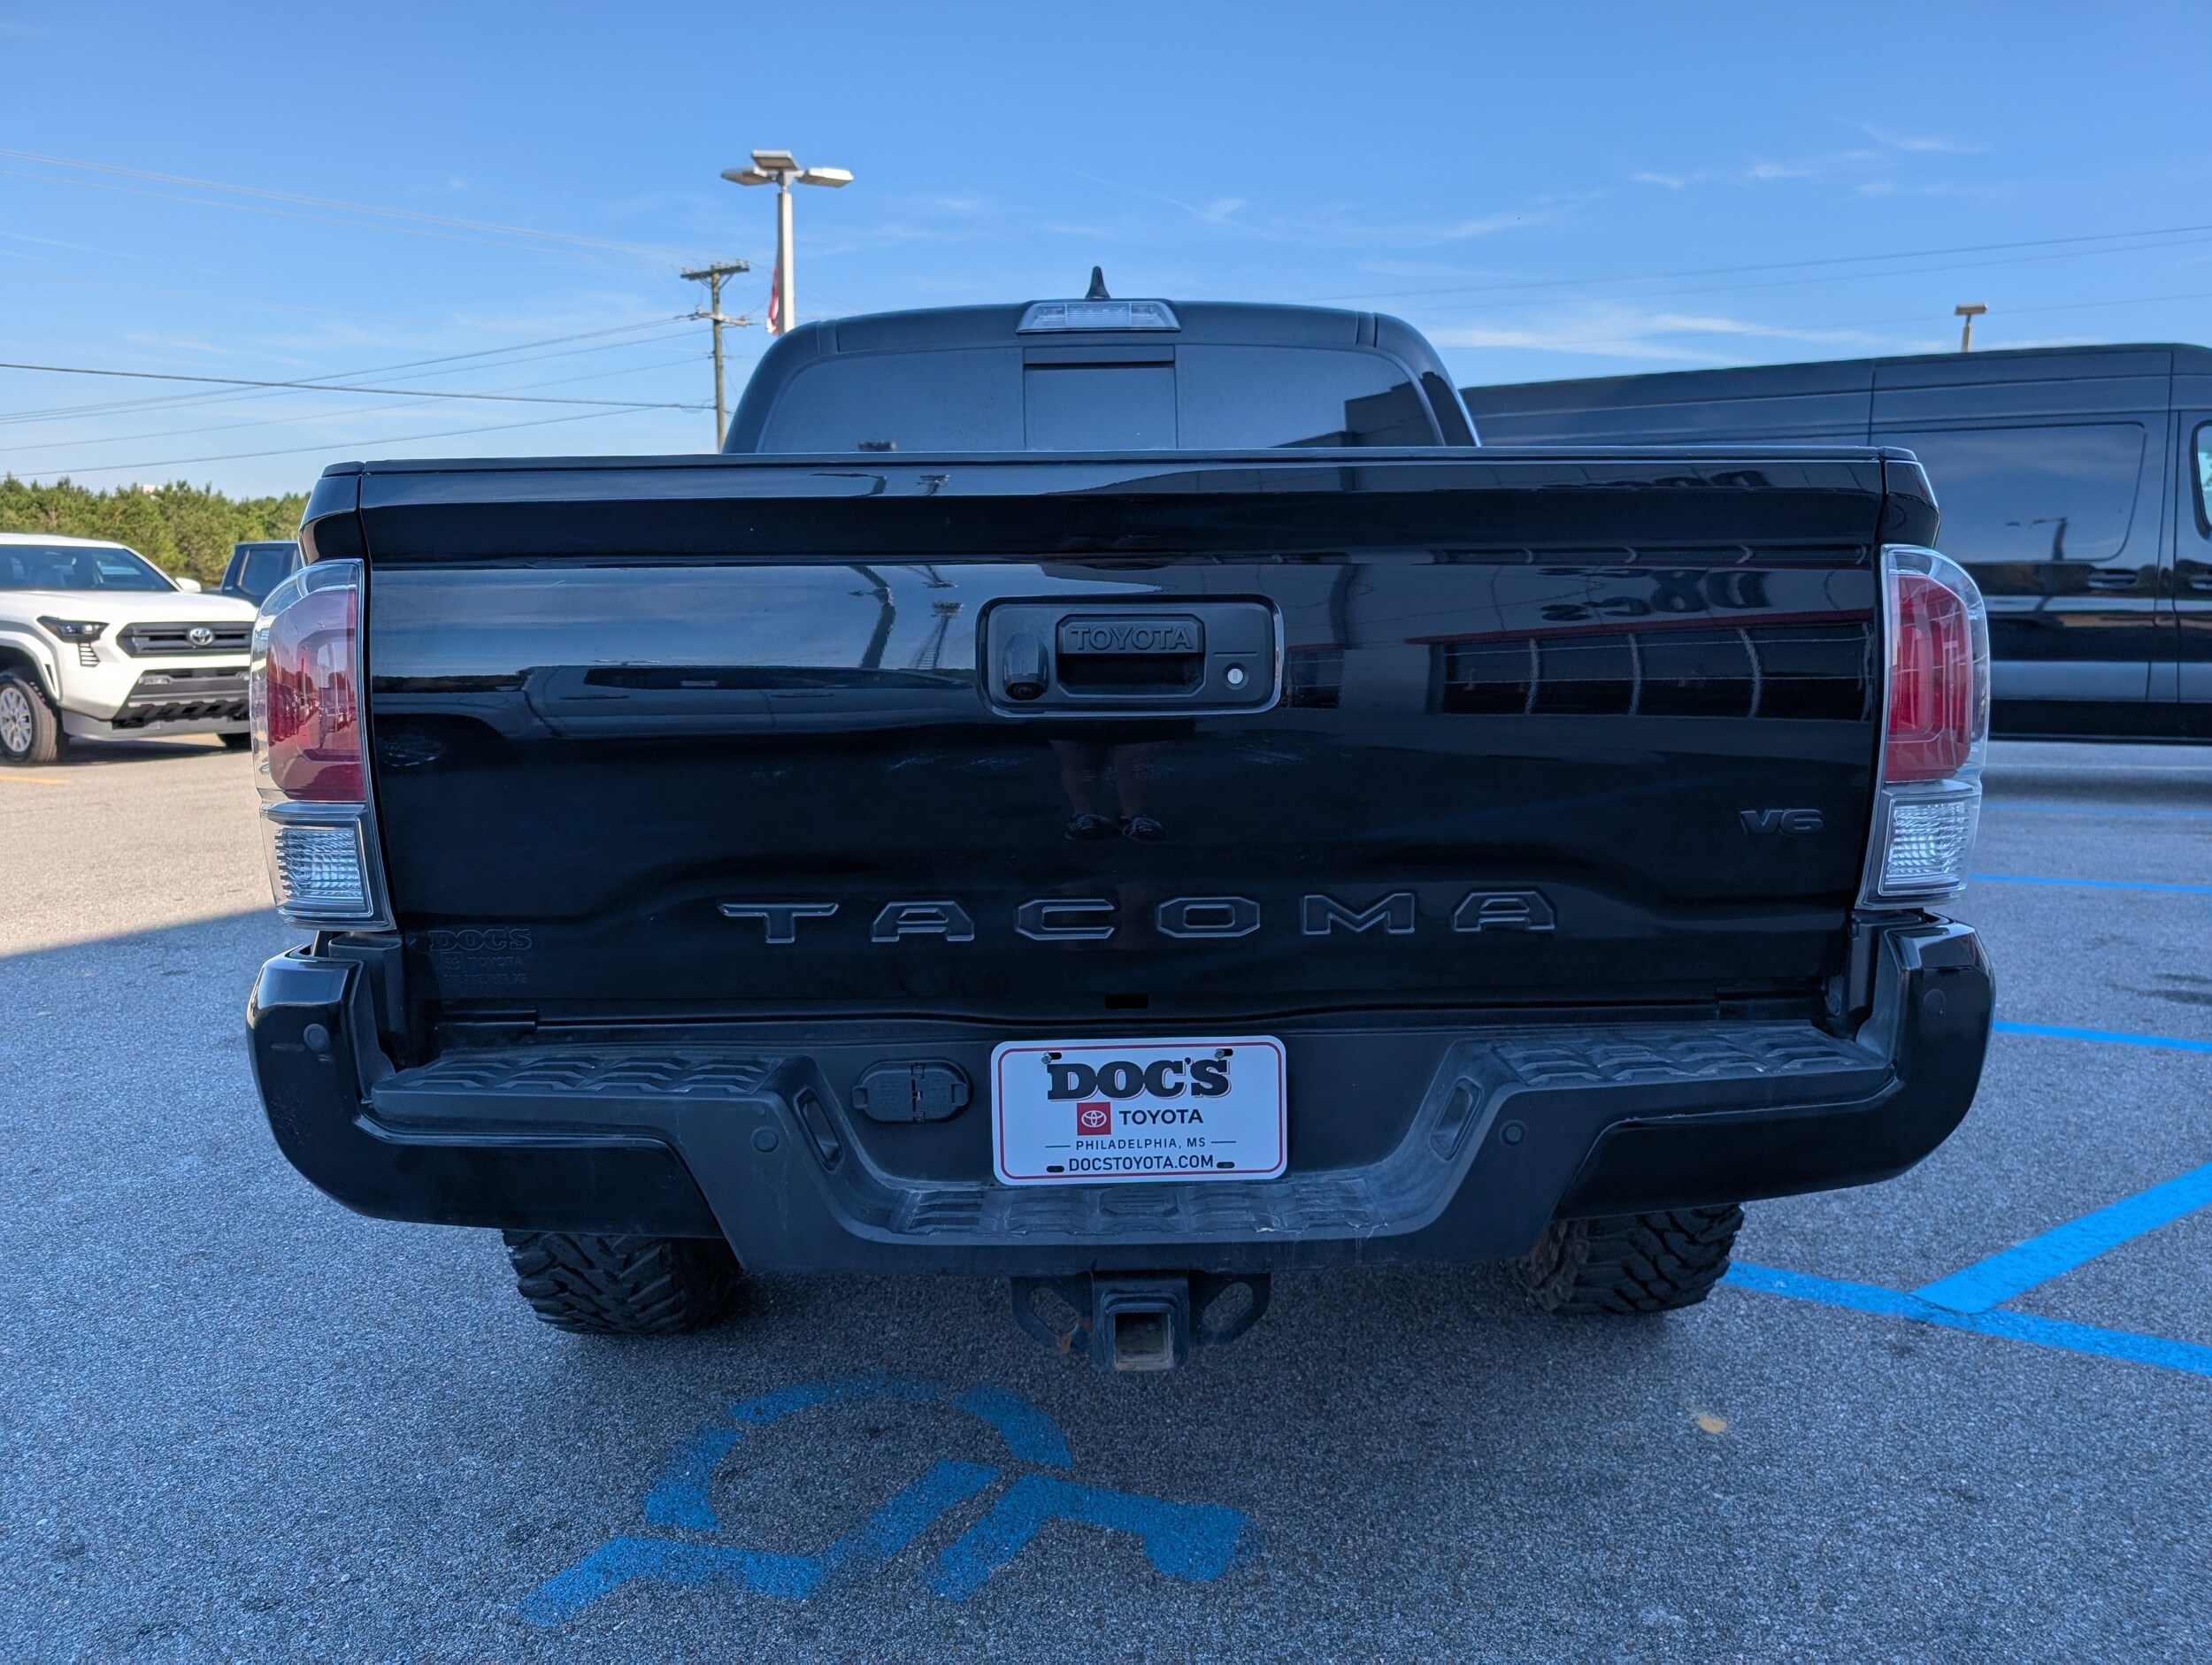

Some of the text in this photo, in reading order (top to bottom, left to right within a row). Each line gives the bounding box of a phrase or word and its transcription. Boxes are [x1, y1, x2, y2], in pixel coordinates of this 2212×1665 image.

[1070, 626, 1194, 651] TOYOTA
[1740, 808, 1824, 835] V6
[717, 890, 1556, 943] TACOMA
[1046, 1056, 1233, 1101] DOC'S
[1118, 1109, 1204, 1126] TOYOTA
[1075, 1137, 1206, 1151] PHILADELPHIA, MS
[1068, 1155, 1214, 1173] DOCSTOYOTA.COM
